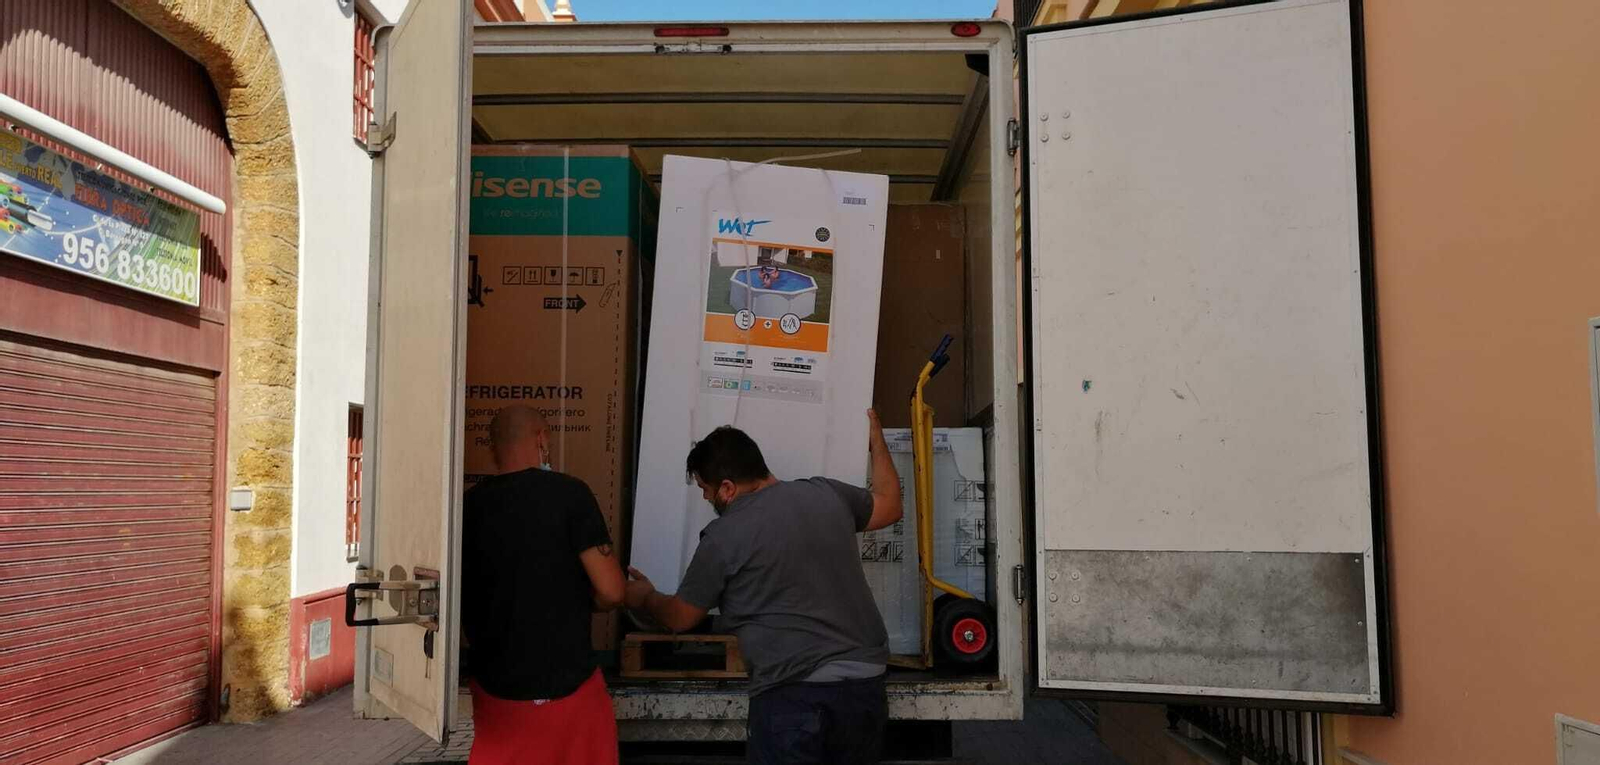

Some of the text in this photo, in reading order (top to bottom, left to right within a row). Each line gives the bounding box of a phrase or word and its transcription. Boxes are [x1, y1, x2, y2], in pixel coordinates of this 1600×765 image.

[471, 171, 602, 198] isense
[63, 233, 109, 273] 956
[117, 250, 196, 298] 833600
[545, 298, 579, 308] FRONT
